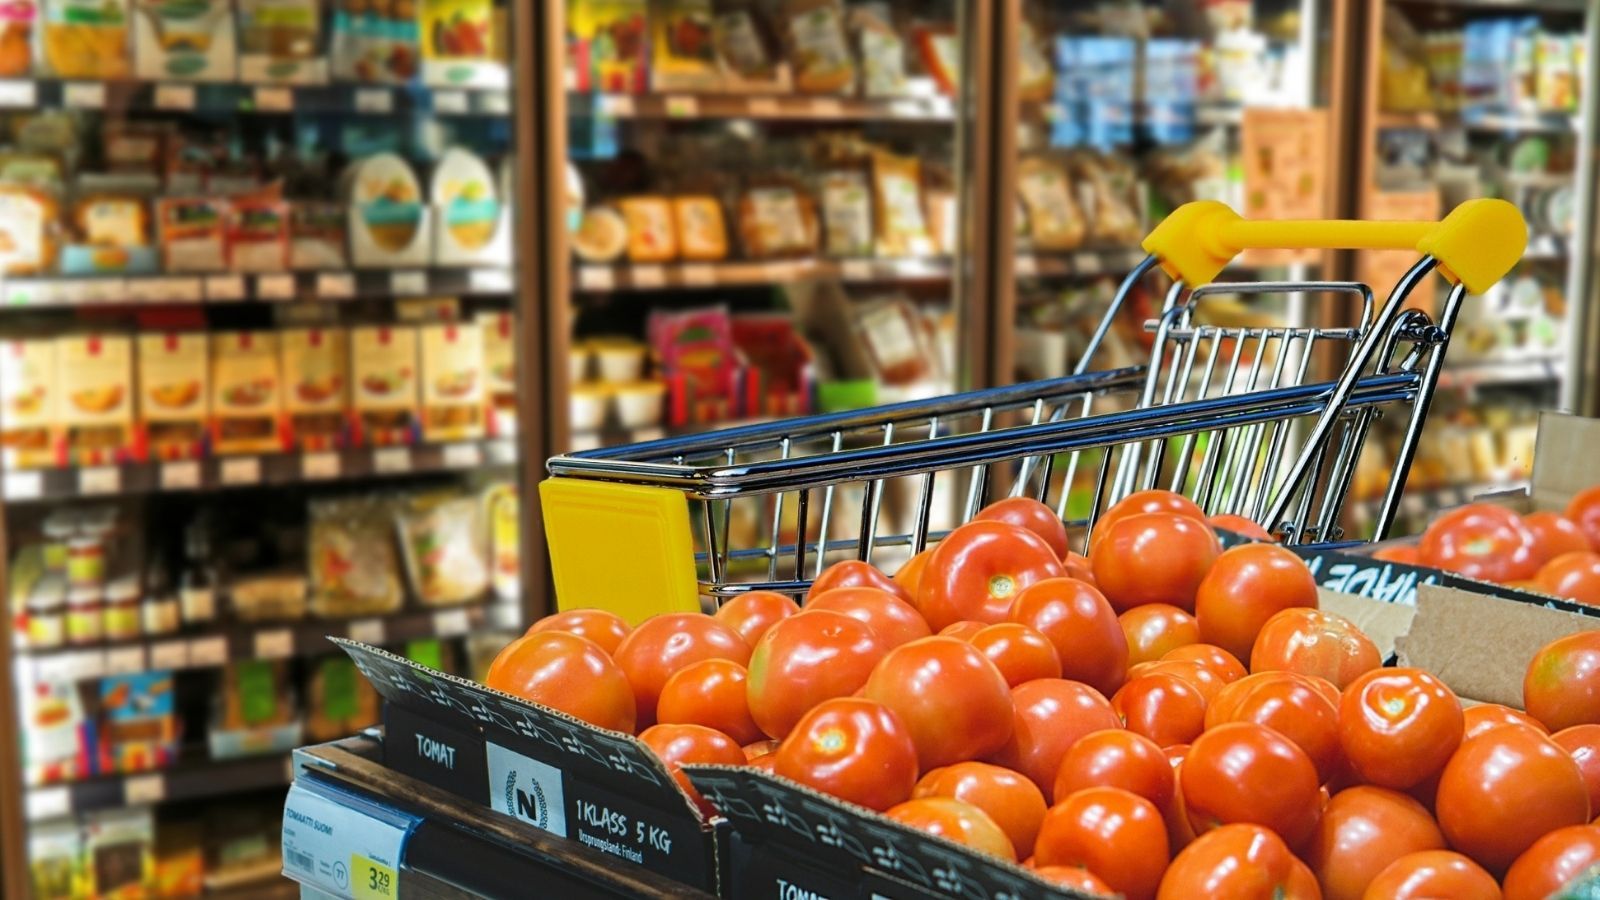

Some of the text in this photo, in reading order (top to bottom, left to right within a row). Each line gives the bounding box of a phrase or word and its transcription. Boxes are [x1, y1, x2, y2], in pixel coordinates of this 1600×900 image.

[415, 733, 456, 770] TOMAT
[516, 788, 537, 821] N
[313, 819, 333, 836] SUOMI
[584, 801, 627, 836] KLASS
[636, 821, 645, 844] 5
[649, 825, 672, 855] KG
[621, 844, 643, 865] Finland
[776, 879, 830, 900] TOM
